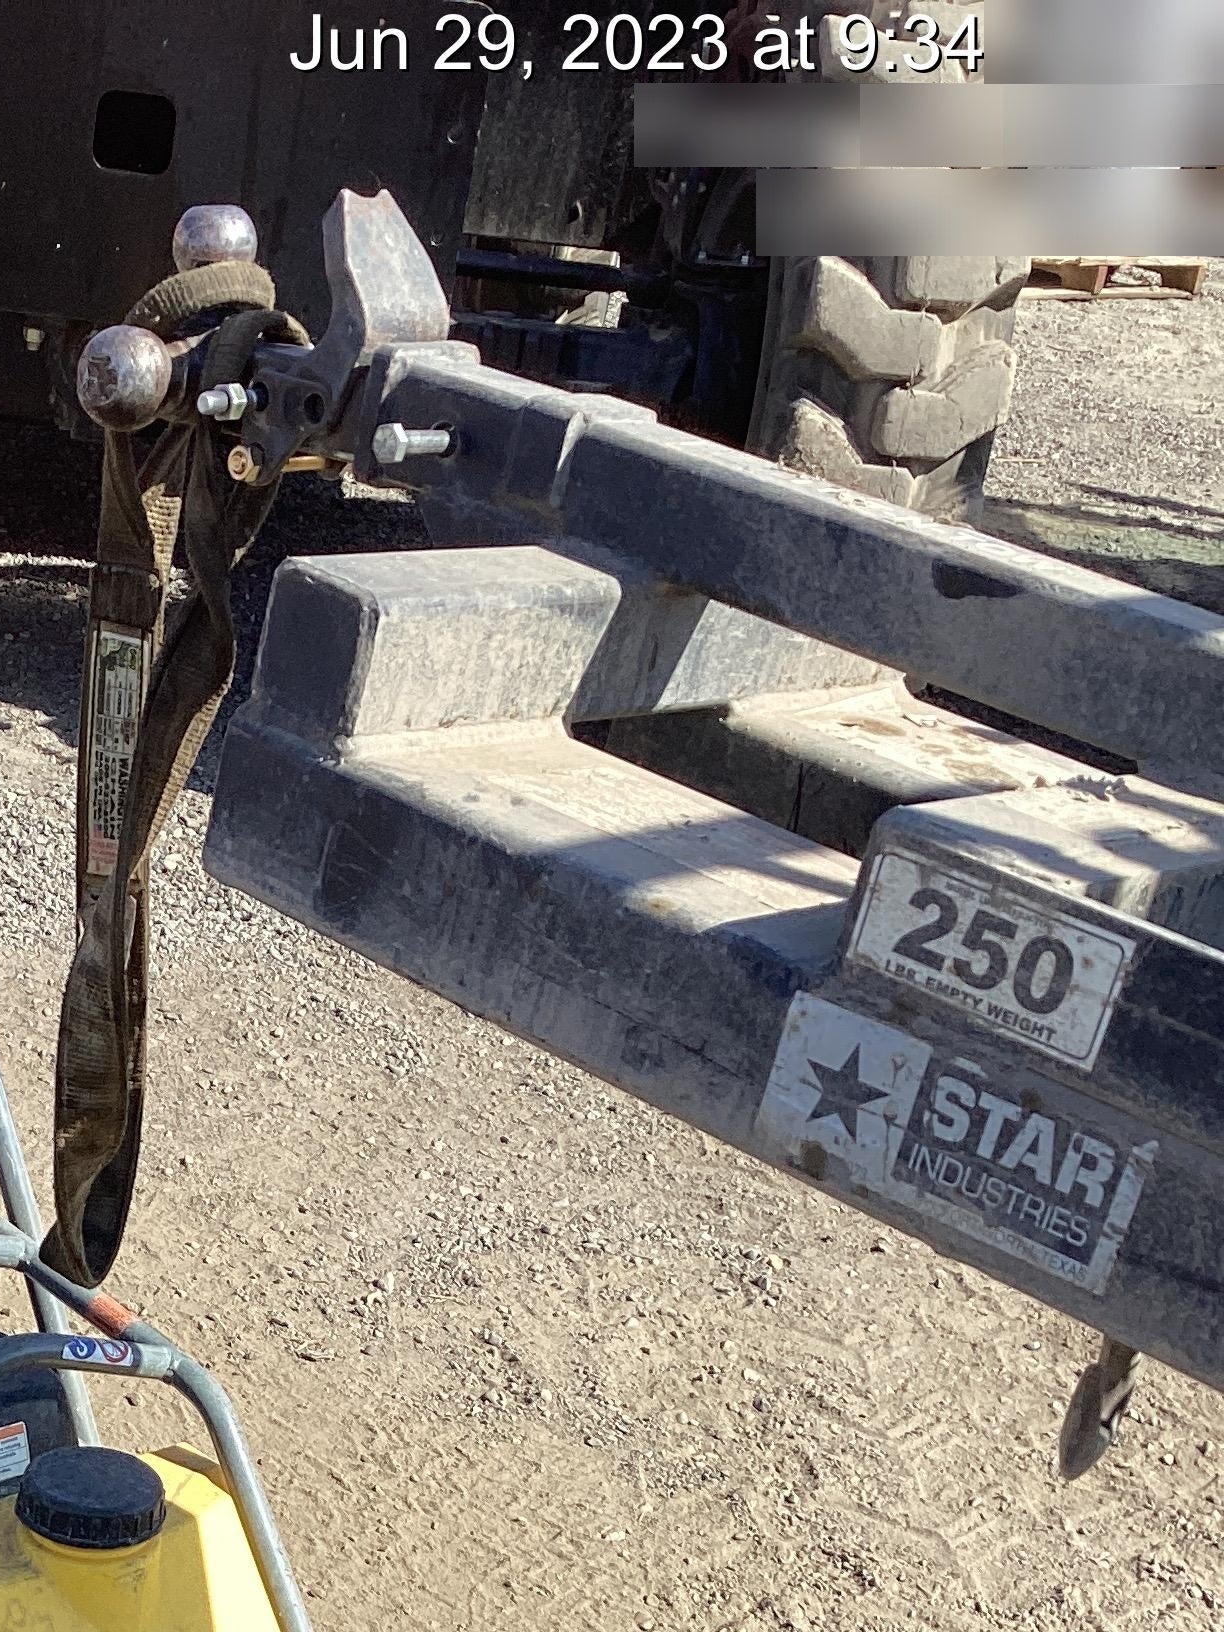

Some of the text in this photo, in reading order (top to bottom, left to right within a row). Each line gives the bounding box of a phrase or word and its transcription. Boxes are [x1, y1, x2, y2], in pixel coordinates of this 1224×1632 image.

[893, 885, 1075, 1016] 250
[925, 976, 983, 1014] EMPTY
[984, 1000, 1057, 1043] WEIGHT
[908, 1142, 1092, 1248] INDUSTRIES
[928, 1072, 1115, 1208] STAR
